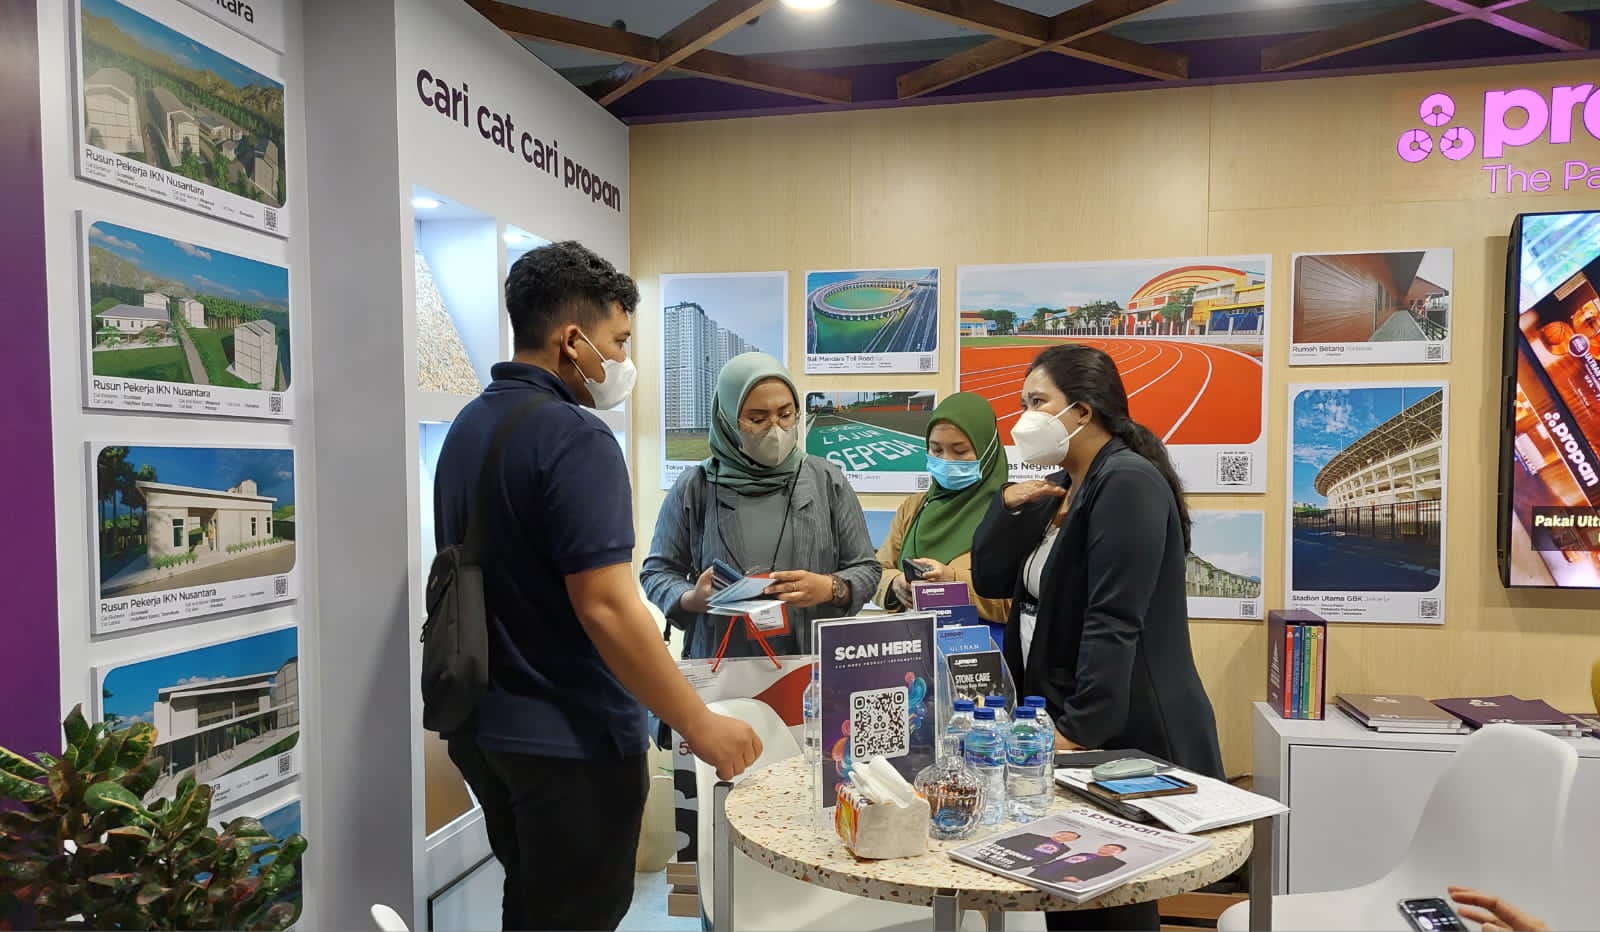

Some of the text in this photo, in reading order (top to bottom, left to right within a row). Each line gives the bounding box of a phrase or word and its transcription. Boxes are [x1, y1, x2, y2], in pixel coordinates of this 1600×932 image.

[1482, 82, 1600, 160] pr
[416, 68, 621, 212] cari cat cari propan
[86, 148, 114, 167] Rusun
[116, 158, 148, 178] Pekerja
[149, 170, 165, 183] IKN
[166, 175, 205, 196] Nusantara
[1480, 162, 1552, 194] The
[1292, 345, 1318, 353] Rumah
[93, 379, 210, 398] Rusun Pekerja IKN Nusantara
[823, 429, 881, 445] LAJUR
[1552, 422, 1600, 487] propan
[1534, 514, 1600, 528] Pakai Ult
[101, 588, 216, 613] Rusun Pekerja IKN Nusantara
[834, 639, 922, 661] SCAN HERE
[955, 672, 991, 684] STONE CARE
[1088, 812, 1161, 837] propan
